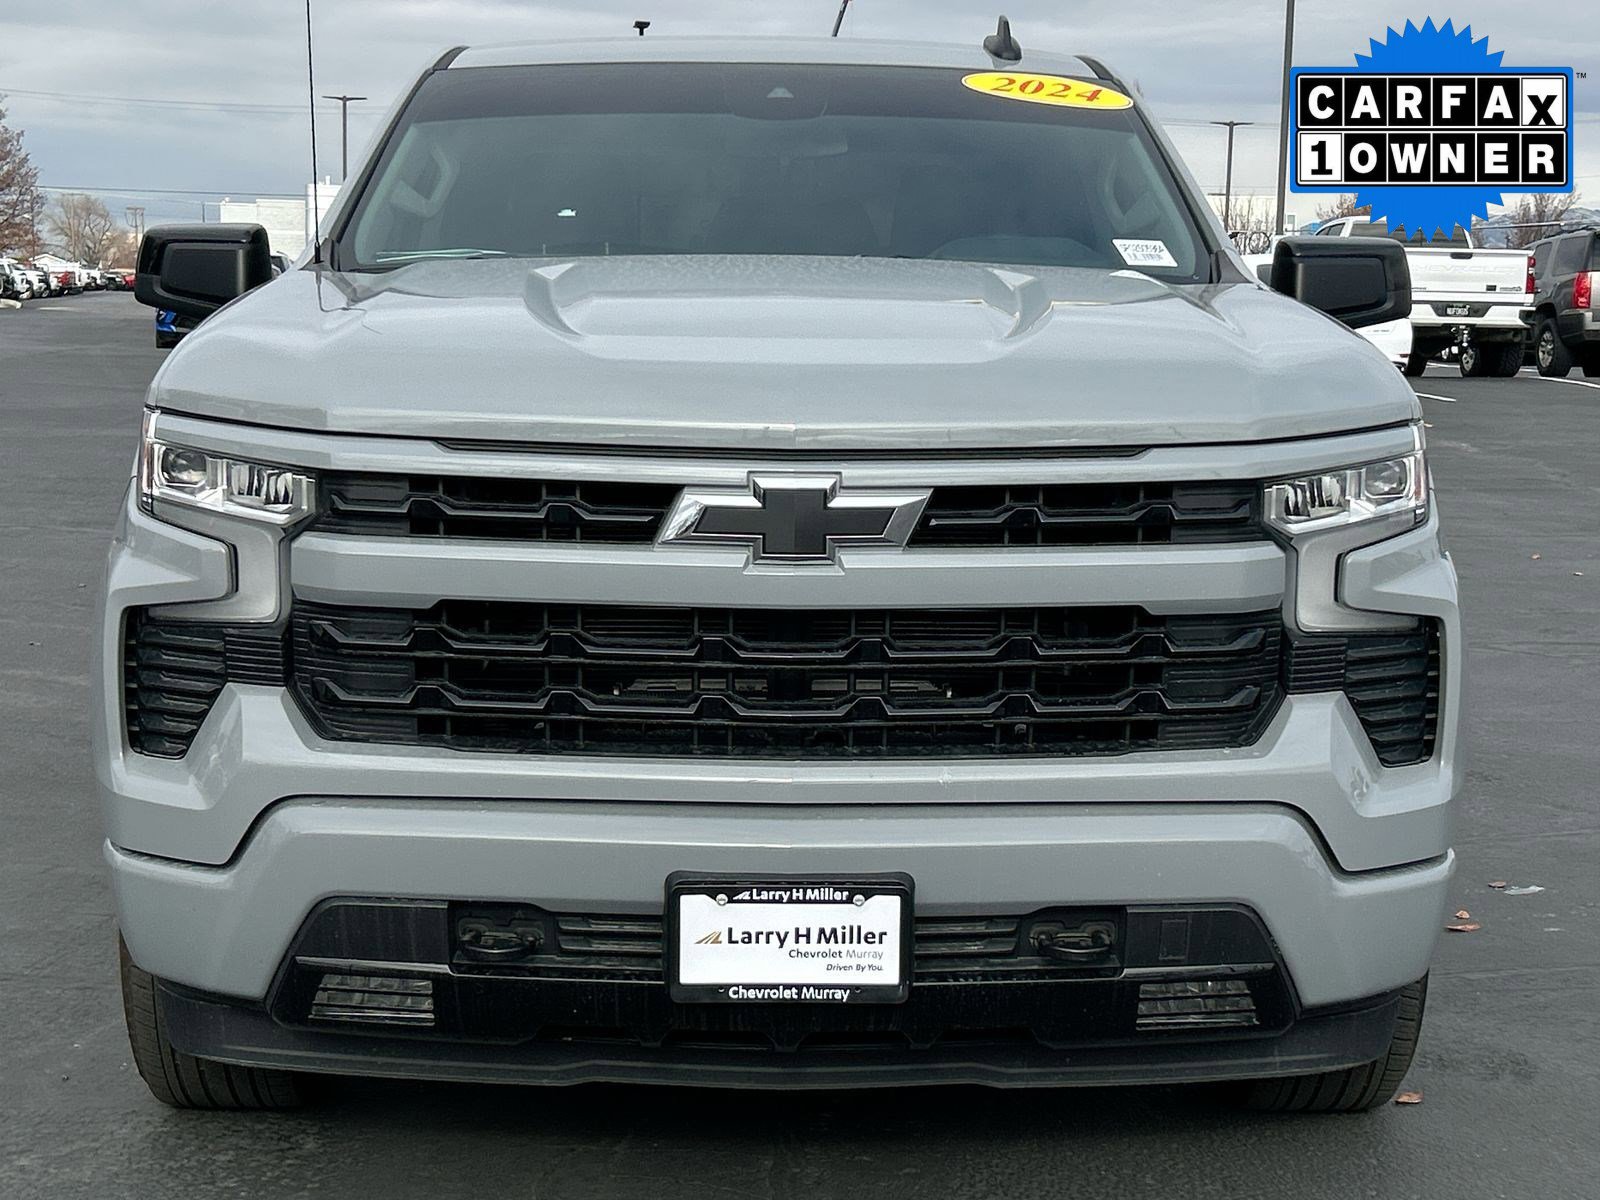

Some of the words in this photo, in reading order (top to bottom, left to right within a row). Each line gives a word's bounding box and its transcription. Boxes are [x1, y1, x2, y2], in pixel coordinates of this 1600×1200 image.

[990, 77, 1103, 102] 2024
[752, 888, 791, 903] Larry
[792, 888, 803, 900] H
[805, 887, 849, 901] Miller
[727, 926, 790, 949] Larry
[794, 927, 811, 945] H
[816, 925, 888, 945] Miller
[788, 949, 843, 959] Chevrolet
[845, 949, 884, 960] Murray
[826, 963, 854, 971] Driven
[855, 963, 866, 972] By
[728, 985, 799, 1000] Chevrolet
[801, 985, 851, 1003] Murray
